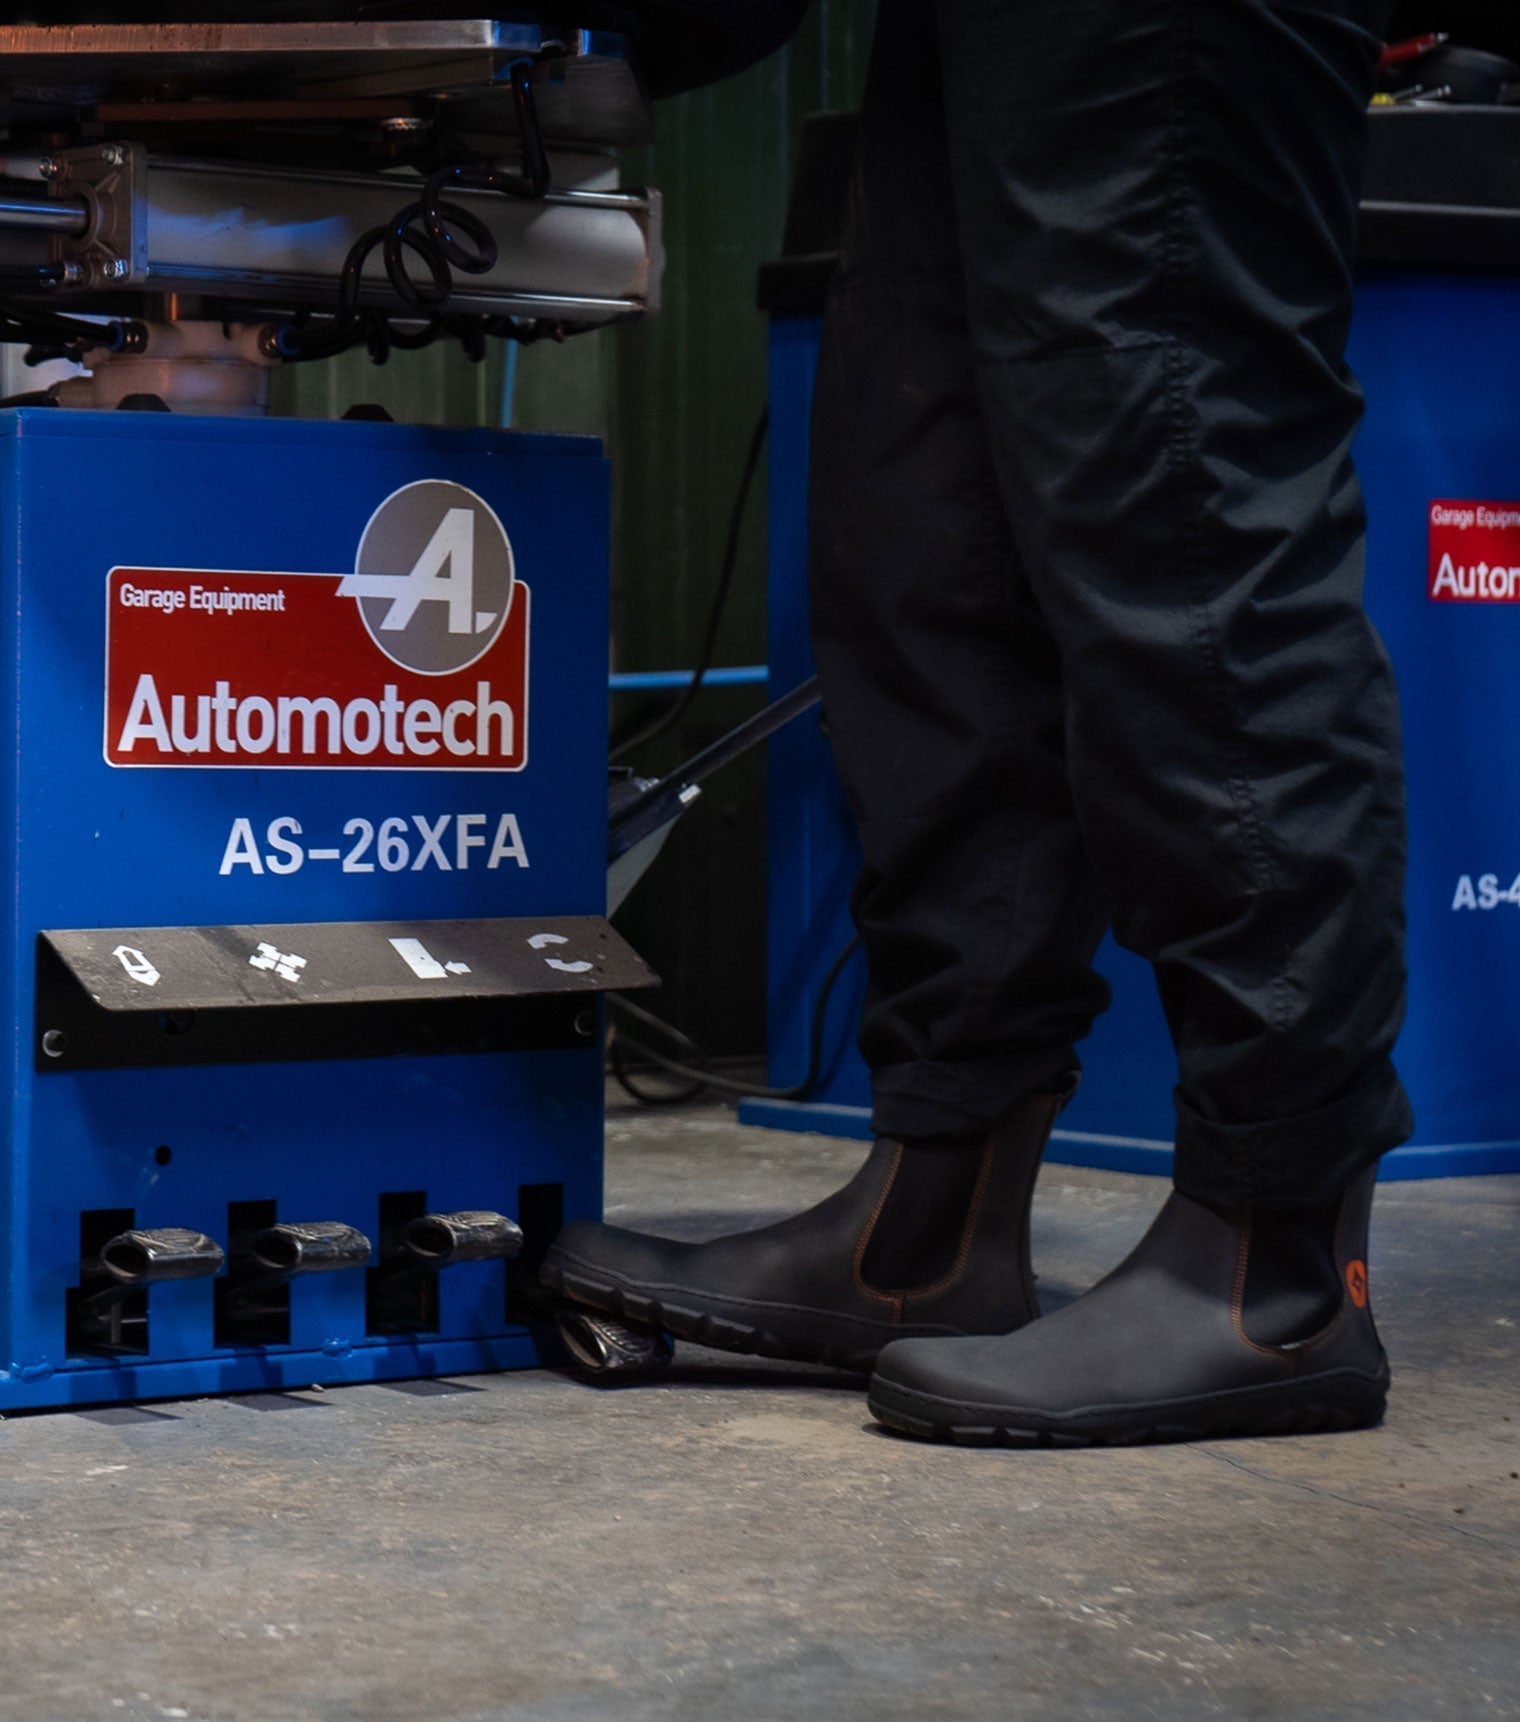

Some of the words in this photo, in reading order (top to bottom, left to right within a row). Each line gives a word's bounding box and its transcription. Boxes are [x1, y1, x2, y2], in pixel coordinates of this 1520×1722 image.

[1431, 504, 1475, 530] Garage
[119, 583, 186, 614] Garage
[189, 585, 286, 615] Equipment
[117, 674, 514, 756] Automotech
[219, 813, 530, 875] AS-26XFA
